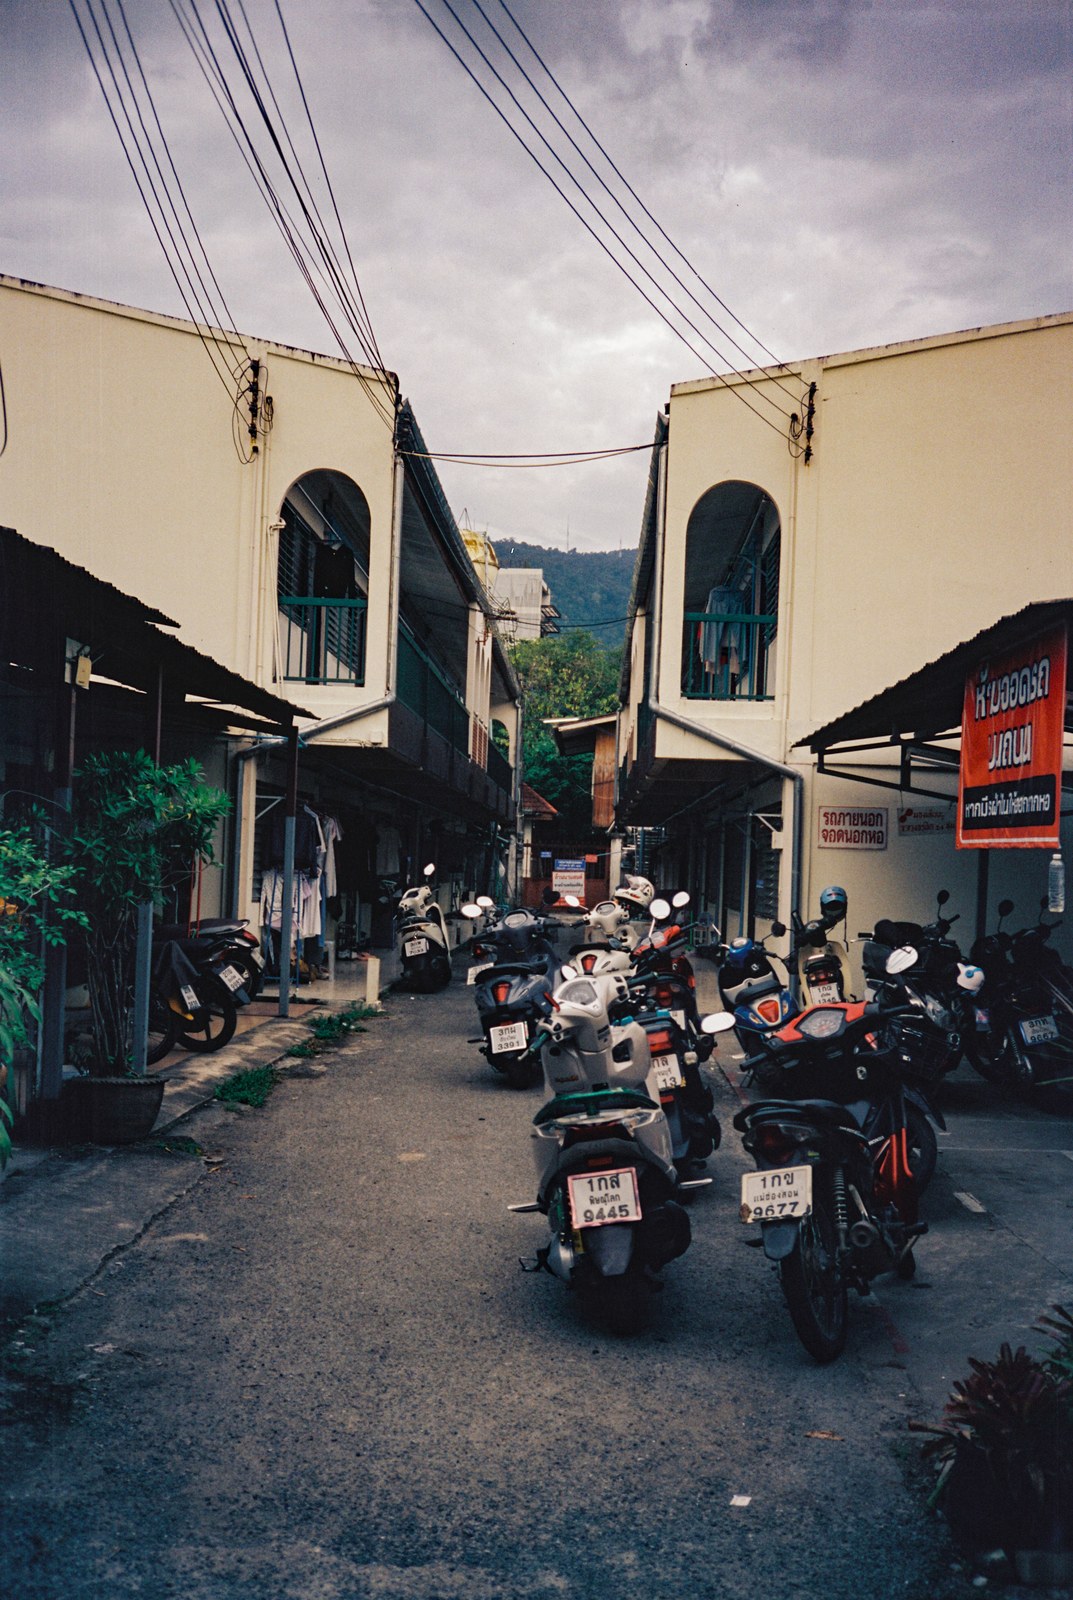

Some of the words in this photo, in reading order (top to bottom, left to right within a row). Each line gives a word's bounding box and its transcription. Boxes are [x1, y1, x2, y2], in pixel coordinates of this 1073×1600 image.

[822, 811, 883, 827] รถภายนอก
[821, 828, 884, 844] จอดนอกหอ
[497, 1041, 521, 1050] 3391
[587, 1173, 621, 1192] 1กส
[761, 1172, 794, 1189] 1กข
[589, 1193, 621, 1205] พิษณุโลก
[753, 1190, 799, 1202] แม่ฮ่องสอน
[583, 1204, 630, 1223] 9445
[753, 1201, 799, 1216] 9677
